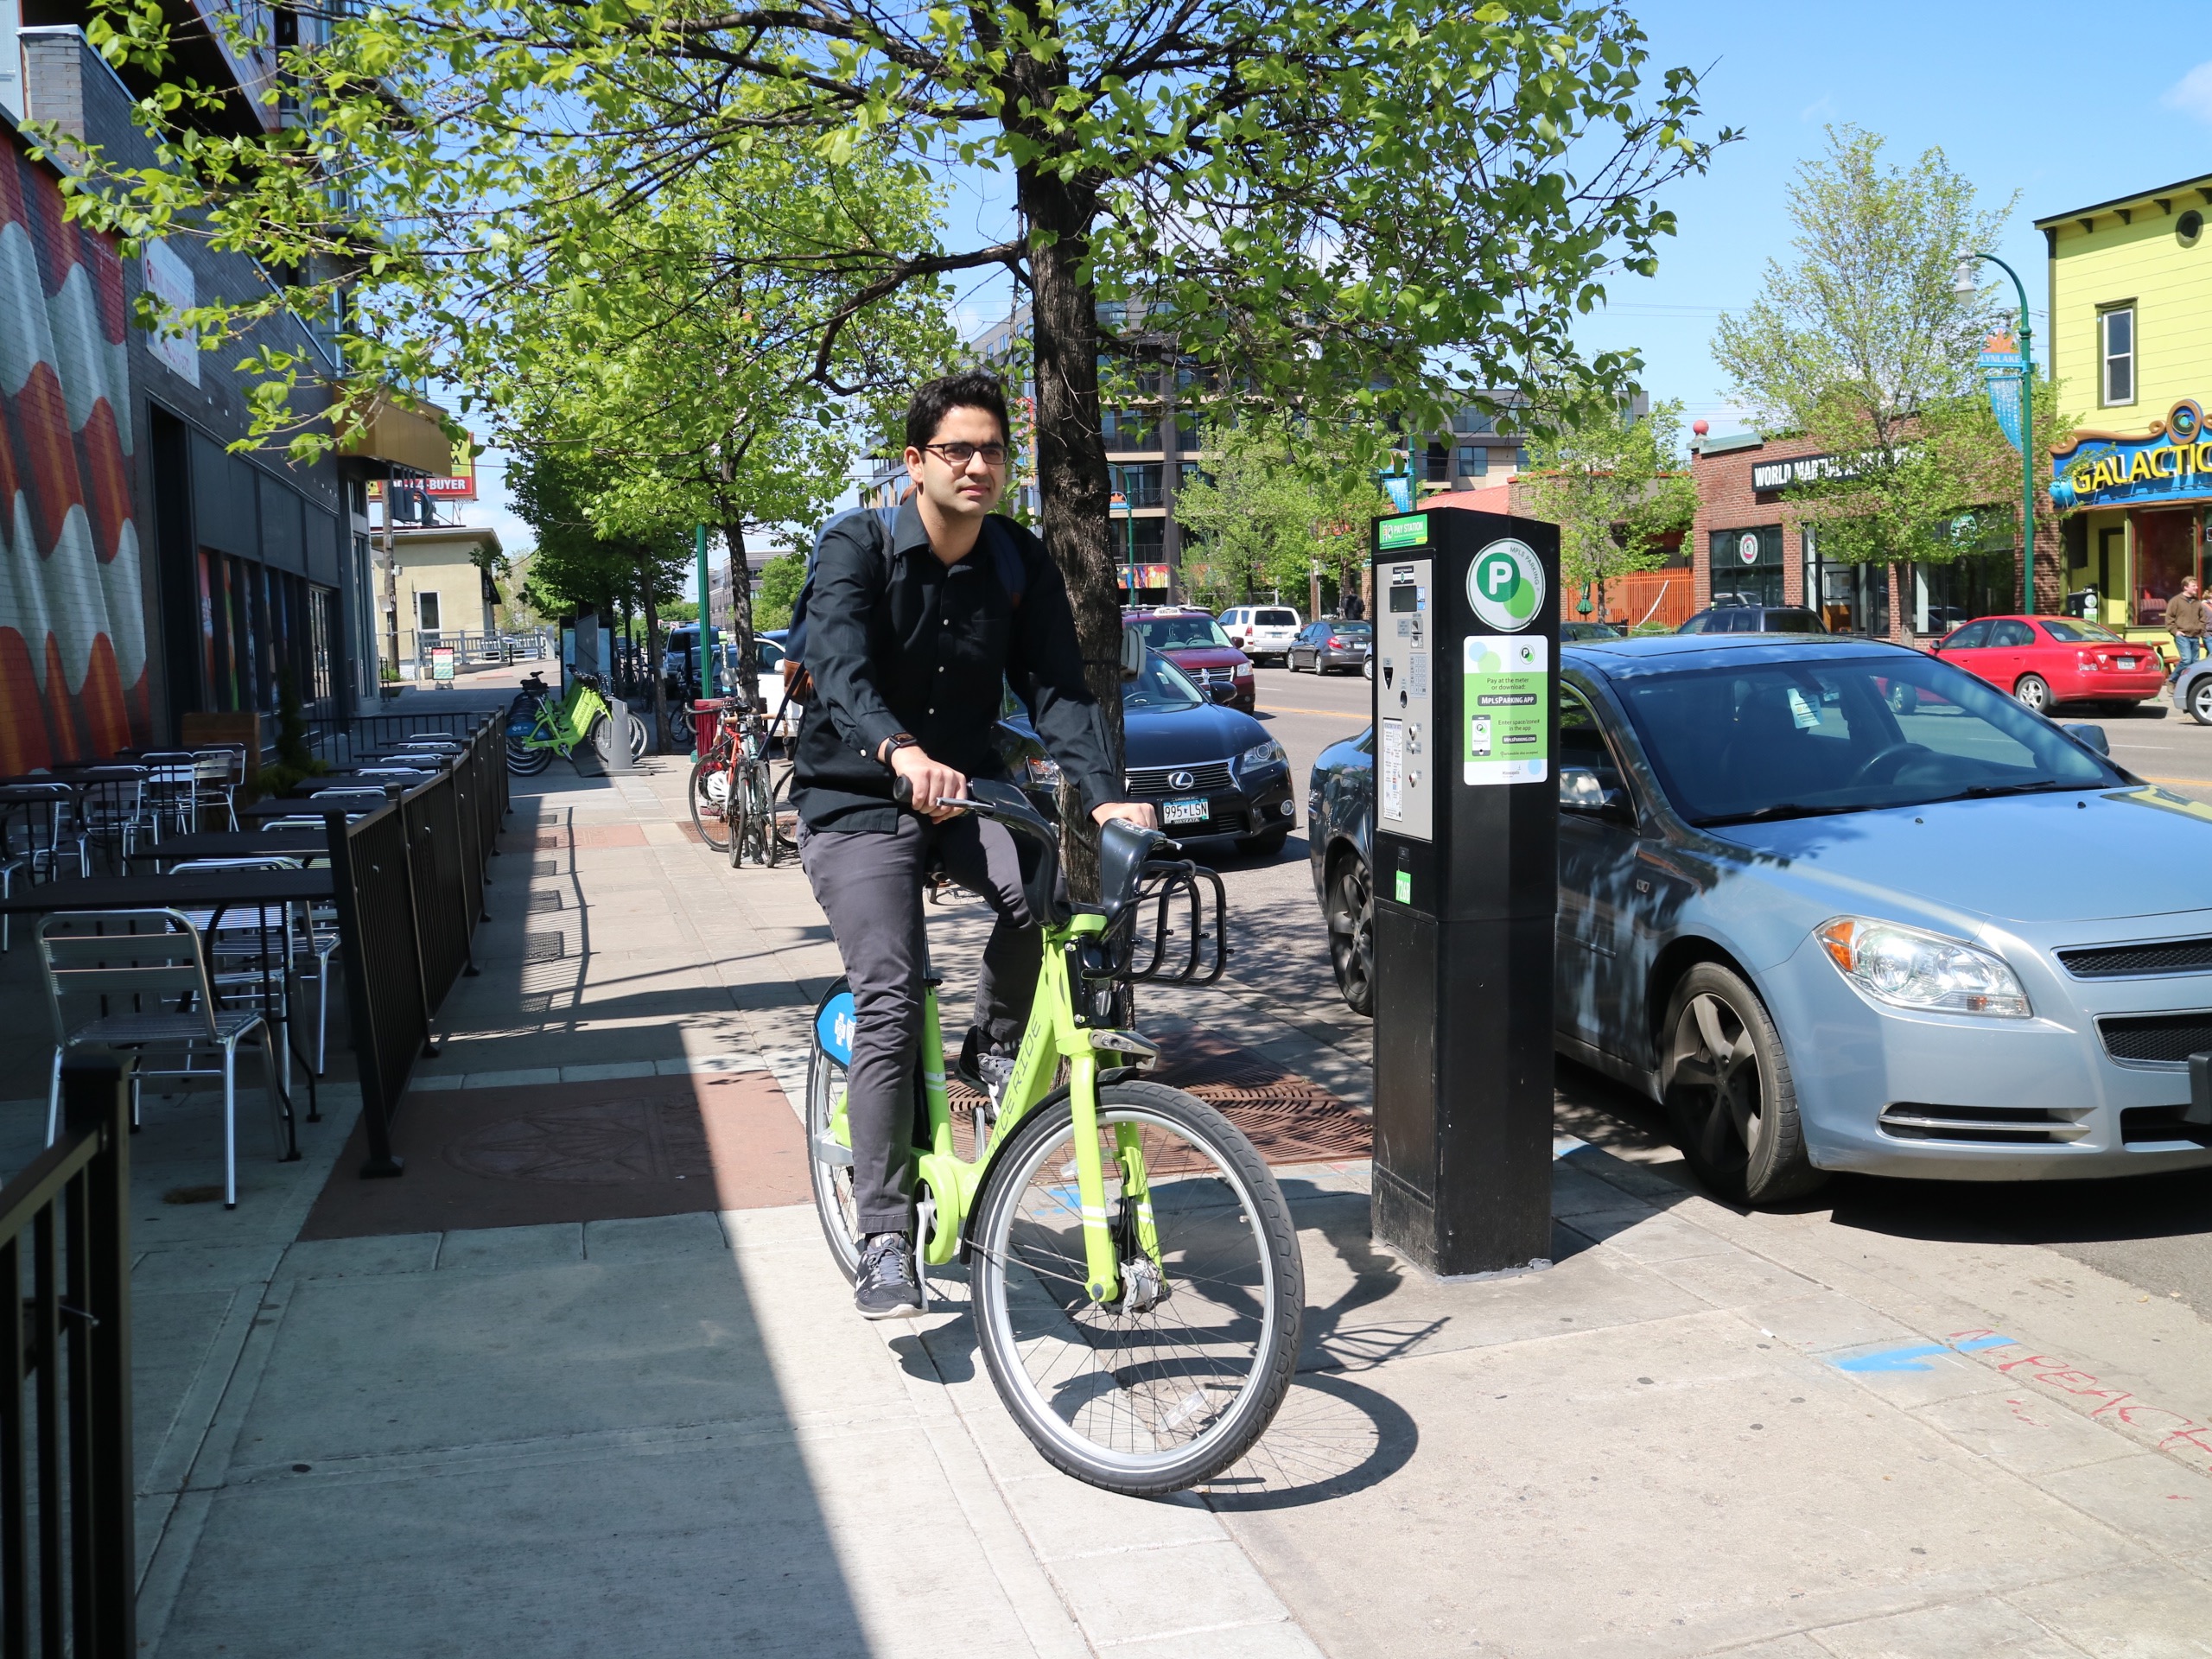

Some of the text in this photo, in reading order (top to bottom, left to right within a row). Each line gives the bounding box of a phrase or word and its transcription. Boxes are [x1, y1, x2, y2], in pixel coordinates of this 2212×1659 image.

[1980, 355, 2020, 364] LYNLAKE
[1754, 463, 1791, 486] WORLD
[1394, 524, 1403, 535] PAY
[1404, 521, 1424, 533] STATION
[1510, 546, 1540, 586] MPLS PARKING
[1489, 561, 1513, 595] P
[1165, 803, 1207, 819] 995 LSN
[1012, 1014, 1041, 1095] RIDE
